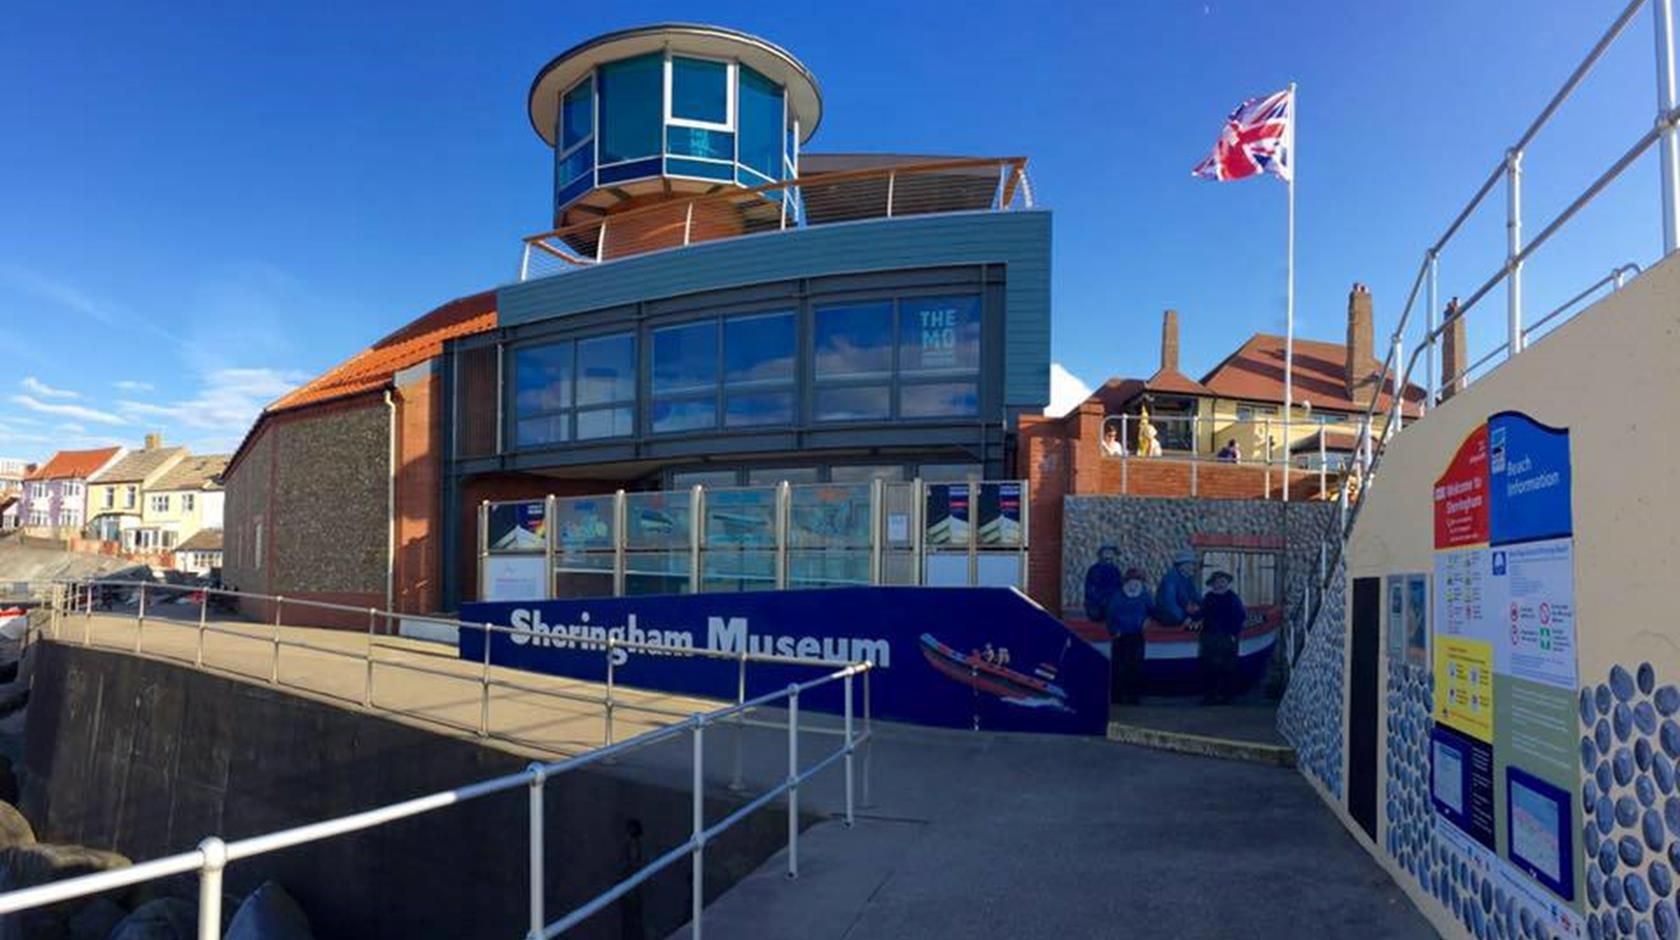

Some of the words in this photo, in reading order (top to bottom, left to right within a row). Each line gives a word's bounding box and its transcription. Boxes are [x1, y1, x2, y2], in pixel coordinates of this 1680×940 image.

[920, 310, 956, 327] THE
[922, 329, 955, 349] MO
[1507, 454, 1532, 477] Beach
[1507, 471, 1560, 497] Information
[510, 608, 693, 666] Sheringham
[707, 616, 890, 668] Museum
